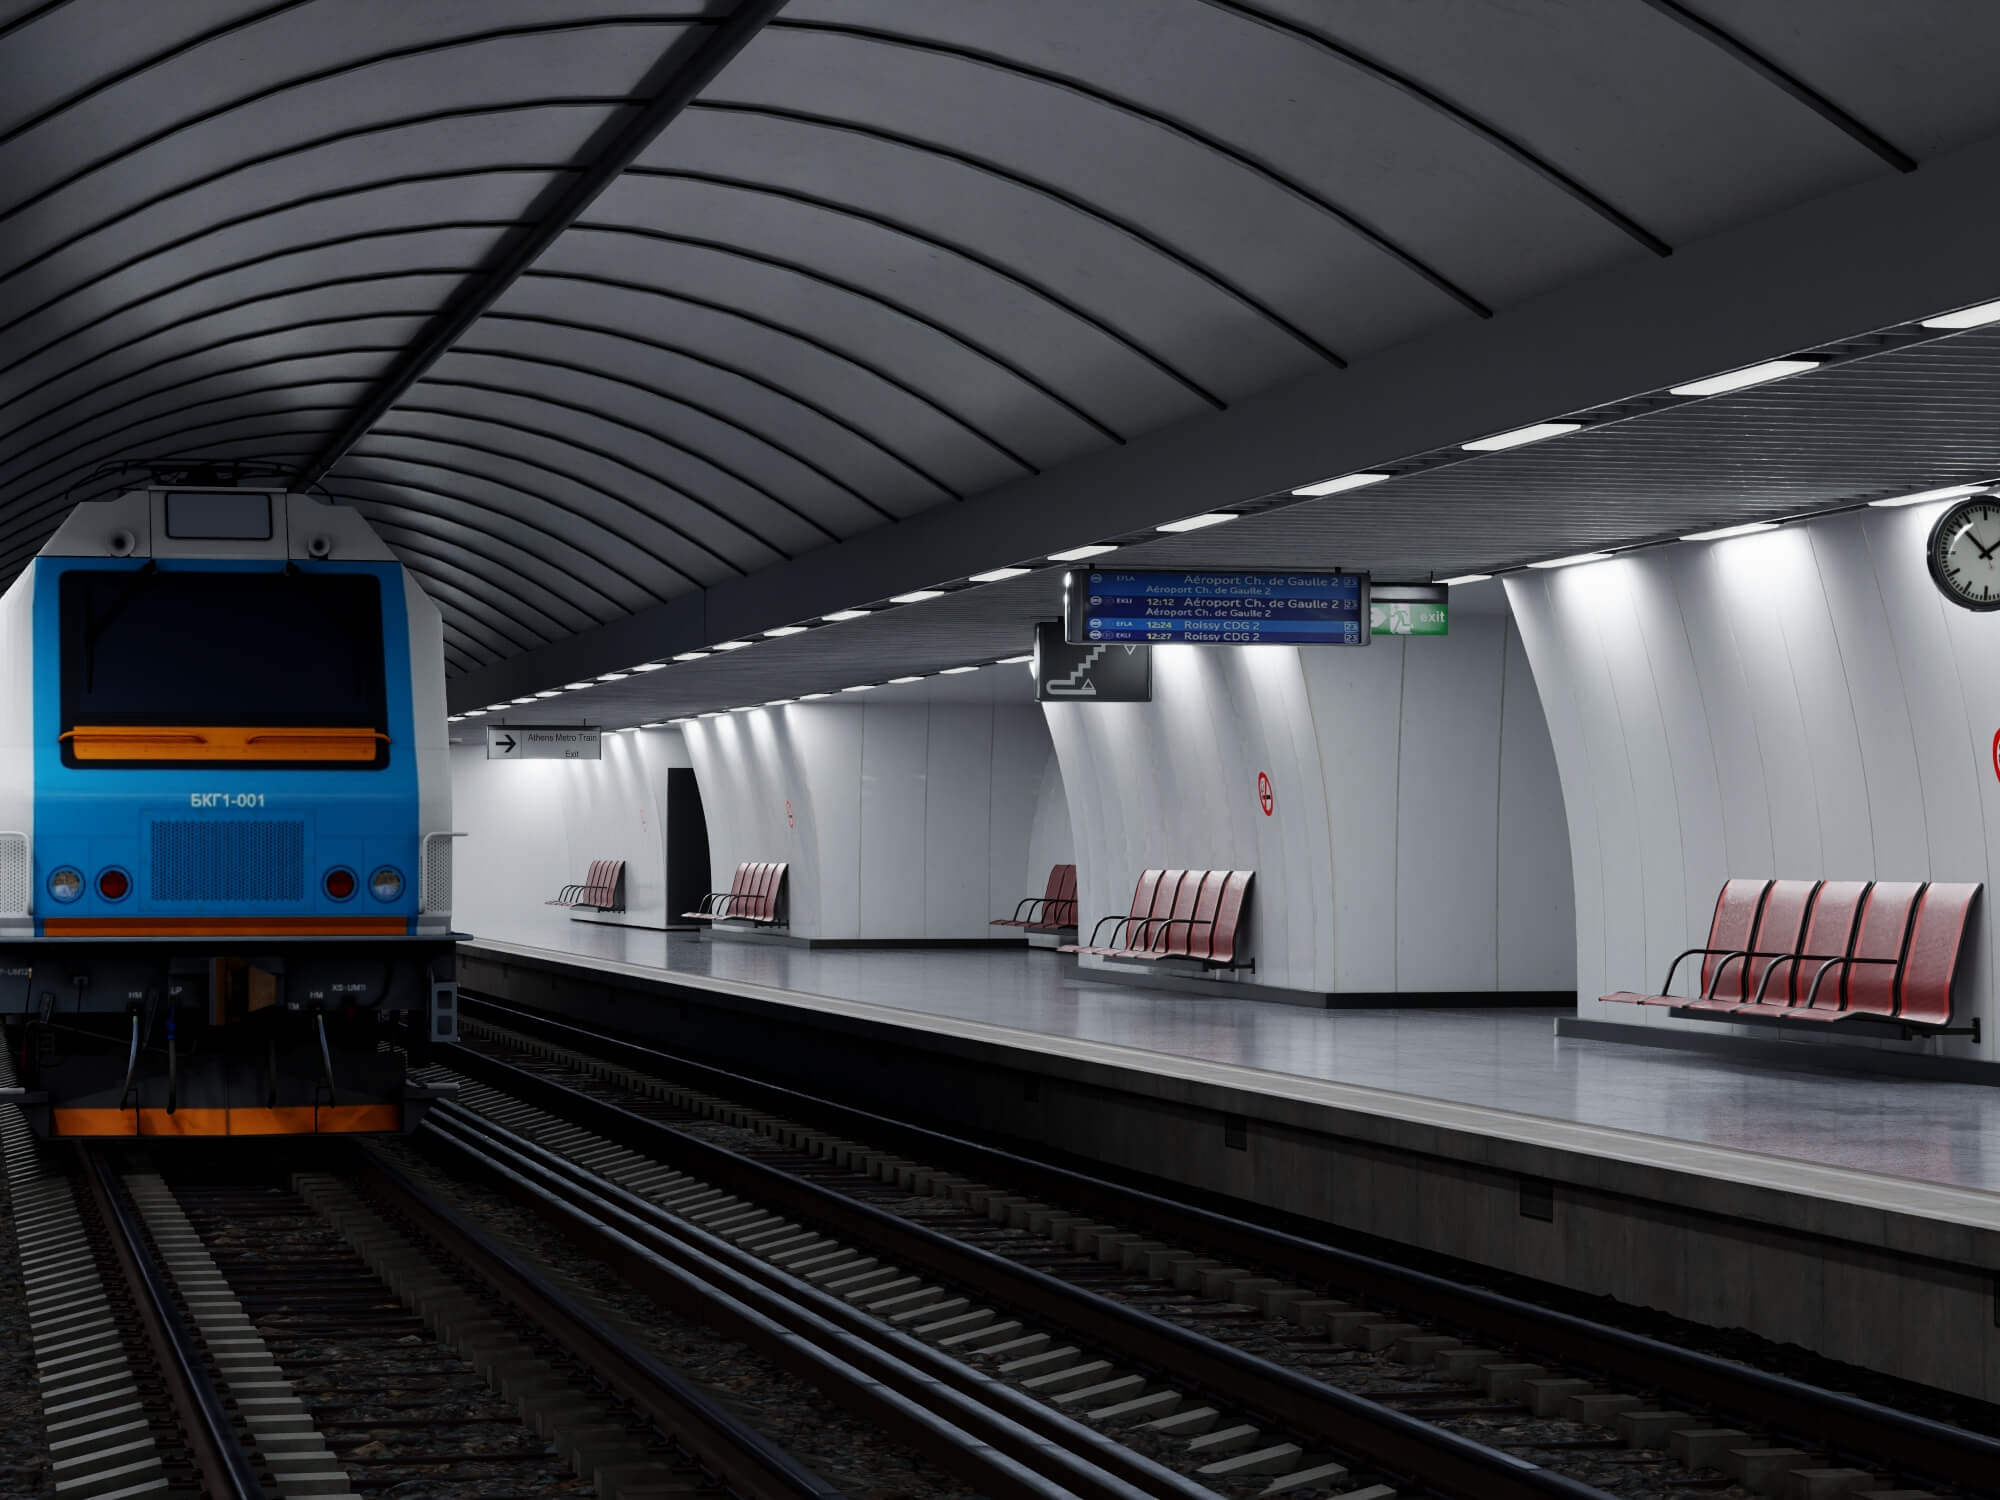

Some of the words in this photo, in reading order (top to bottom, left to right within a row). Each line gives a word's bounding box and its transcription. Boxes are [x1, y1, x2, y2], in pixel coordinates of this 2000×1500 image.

[1184, 576, 1240, 586] Aéroport
[1244, 576, 1266, 586] Ch.
[1269, 577, 1285, 586] de
[1287, 577, 1328, 587] Gaulle
[1331, 578, 1339, 586] 2
[1146, 586, 1193, 595] Aéroport
[1195, 586, 1213, 594] Ch.
[1215, 586, 1227, 594] de
[1230, 587, 1263, 595] Gaulle
[1264, 587, 1272, 595] 2
[1146, 598, 1175, 606] 12:12
[1184, 598, 1240, 608] Aéroport
[1244, 599, 1266, 608] Ch.
[1269, 599, 1285, 608] de
[1287, 599, 1329, 609] Gaulle
[1331, 600, 1339, 609] 2
[1146, 608, 1193, 617] Aéroport
[1194, 609, 1213, 617] Ch.
[1215, 609, 1227, 617] de
[1230, 609, 1263, 617] Gaulle
[1264, 609, 1272, 617] 2
[1420, 611, 1445, 624] exit
[1184, 621, 1220, 631] Roissy
[1223, 621, 1250, 630] CDG
[1252, 621, 1260, 630] 2
[1184, 632, 1220, 642] Roissy
[1223, 633, 1250, 641] CDG
[1252, 633, 1260, 641] 2
[528, 733, 554, 742] Athens
[555, 733, 577, 742] Metro
[578, 733, 597, 742] Train
[191, 793, 265, 808] БКГ1-001
